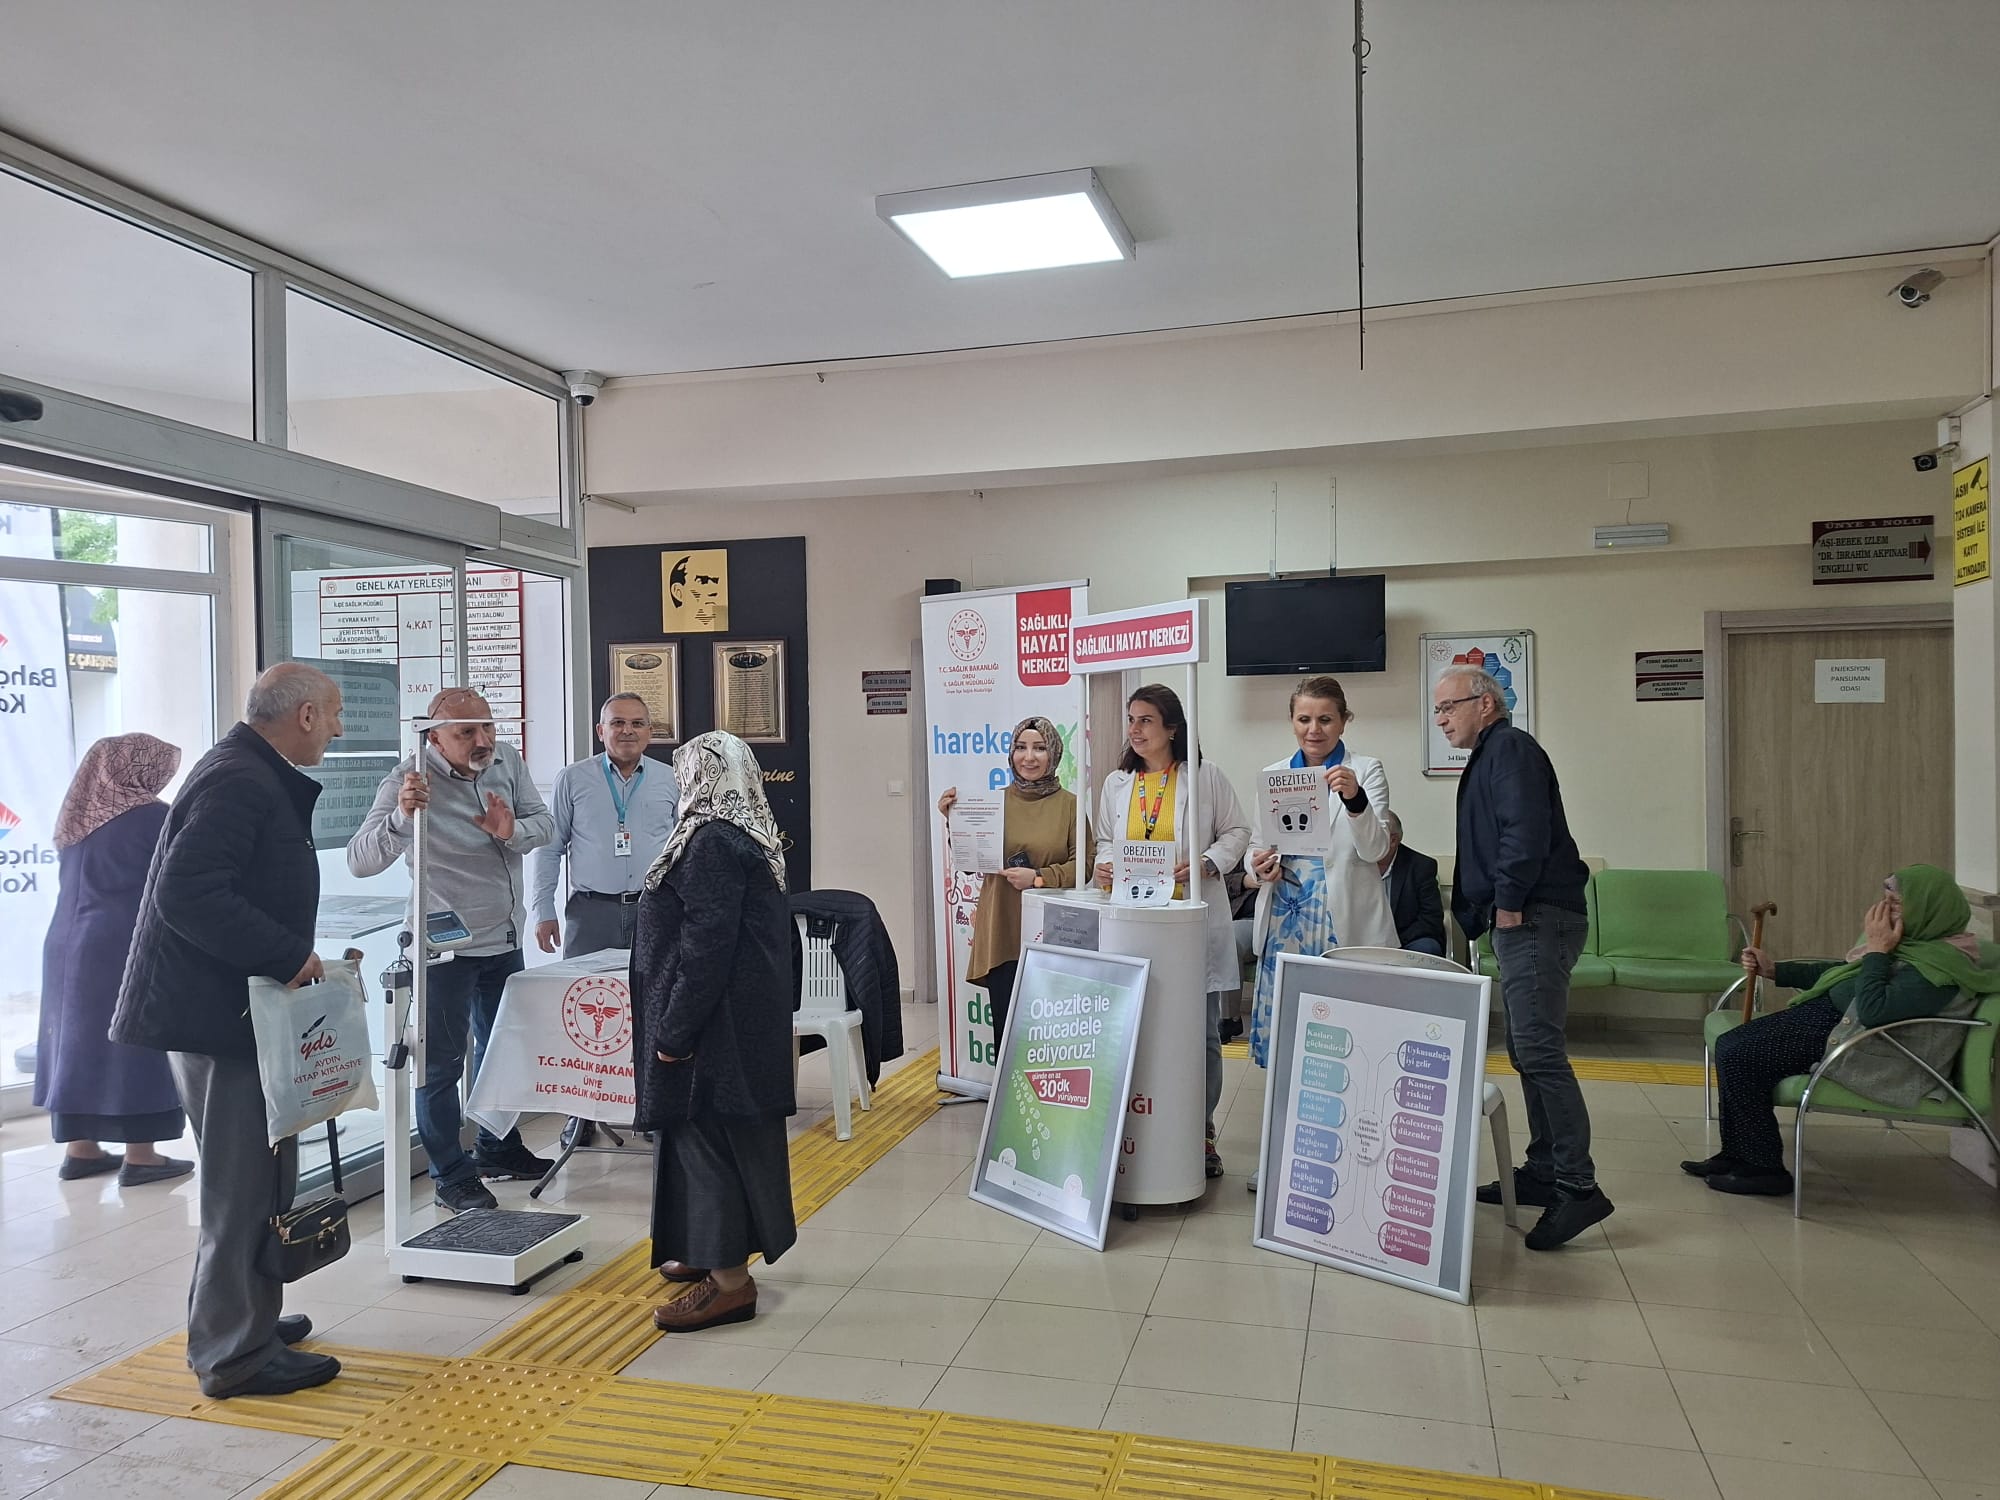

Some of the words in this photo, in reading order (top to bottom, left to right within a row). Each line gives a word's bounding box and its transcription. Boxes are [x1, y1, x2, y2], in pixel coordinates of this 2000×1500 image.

[1955, 482, 1969, 499] ASM
[1965, 500, 1987, 518] KAMERA
[1882, 518, 1921, 527] NOLU
[1873, 547, 1908, 558] AKPINAR
[1963, 543, 1978, 558] KAYIT
[1856, 562, 1869, 572] WC
[355, 580, 385, 591] GENEL
[387, 579, 405, 590] KAT
[408, 576, 453, 590] YERLEŞİM
[406, 620, 433, 631] 4.KAT
[1020, 612, 1068, 632] SAĞLIKLI
[1021, 632, 1067, 655] HAYAT
[1076, 634, 1114, 657] SAĞLIKLI
[1116, 630, 1148, 652] HAYAT
[1149, 619, 1190, 648] MERKEZİ
[948, 664, 969, 673] SAĞLIK
[1022, 652, 1068, 675] MERKEZİ
[407, 683, 434, 694] 3.KAT
[933, 723, 1011, 755] hareke
[1268, 770, 1317, 787] OBEZİTEYİ
[1123, 844, 1166, 857] OBEZİTEYİ
[1030, 993, 1092, 1020] Obezite
[1094, 994, 1110, 1013] ile
[1028, 1015, 1102, 1041] mücadele
[1306, 1028, 1333, 1040] Kasları
[1027, 1038, 1096, 1067] ediyoruz!
[315, 1054, 341, 1068] AYDIN
[537, 1055, 558, 1067] T.C.
[560, 1056, 594, 1072] SAĞLIK
[595, 1063, 635, 1078] BAKAN
[1405, 1056, 1415, 1066] iyi
[1415, 1059, 1432, 1069] gelir
[583, 1074, 603, 1089] ÜNYE
[1032, 1073, 1047, 1081] günde
[1407, 1078, 1436, 1091] Kanser
[535, 1082, 558, 1095] İLÇE
[560, 1084, 588, 1099] SAĞLIK
[589, 1091, 636, 1105] MÜDÜRLÜ
[1038, 1079, 1057, 1098] 30
[1057, 1079, 1070, 1093] dk
[1406, 1089, 1432, 1101] riskini
[1057, 1092, 1087, 1104] yürüyoruz
[1405, 1101, 1432, 1112] azaltır
[1399, 1116, 1443, 1133] Kolesterolü
[1397, 1127, 1432, 1141] düzenler
